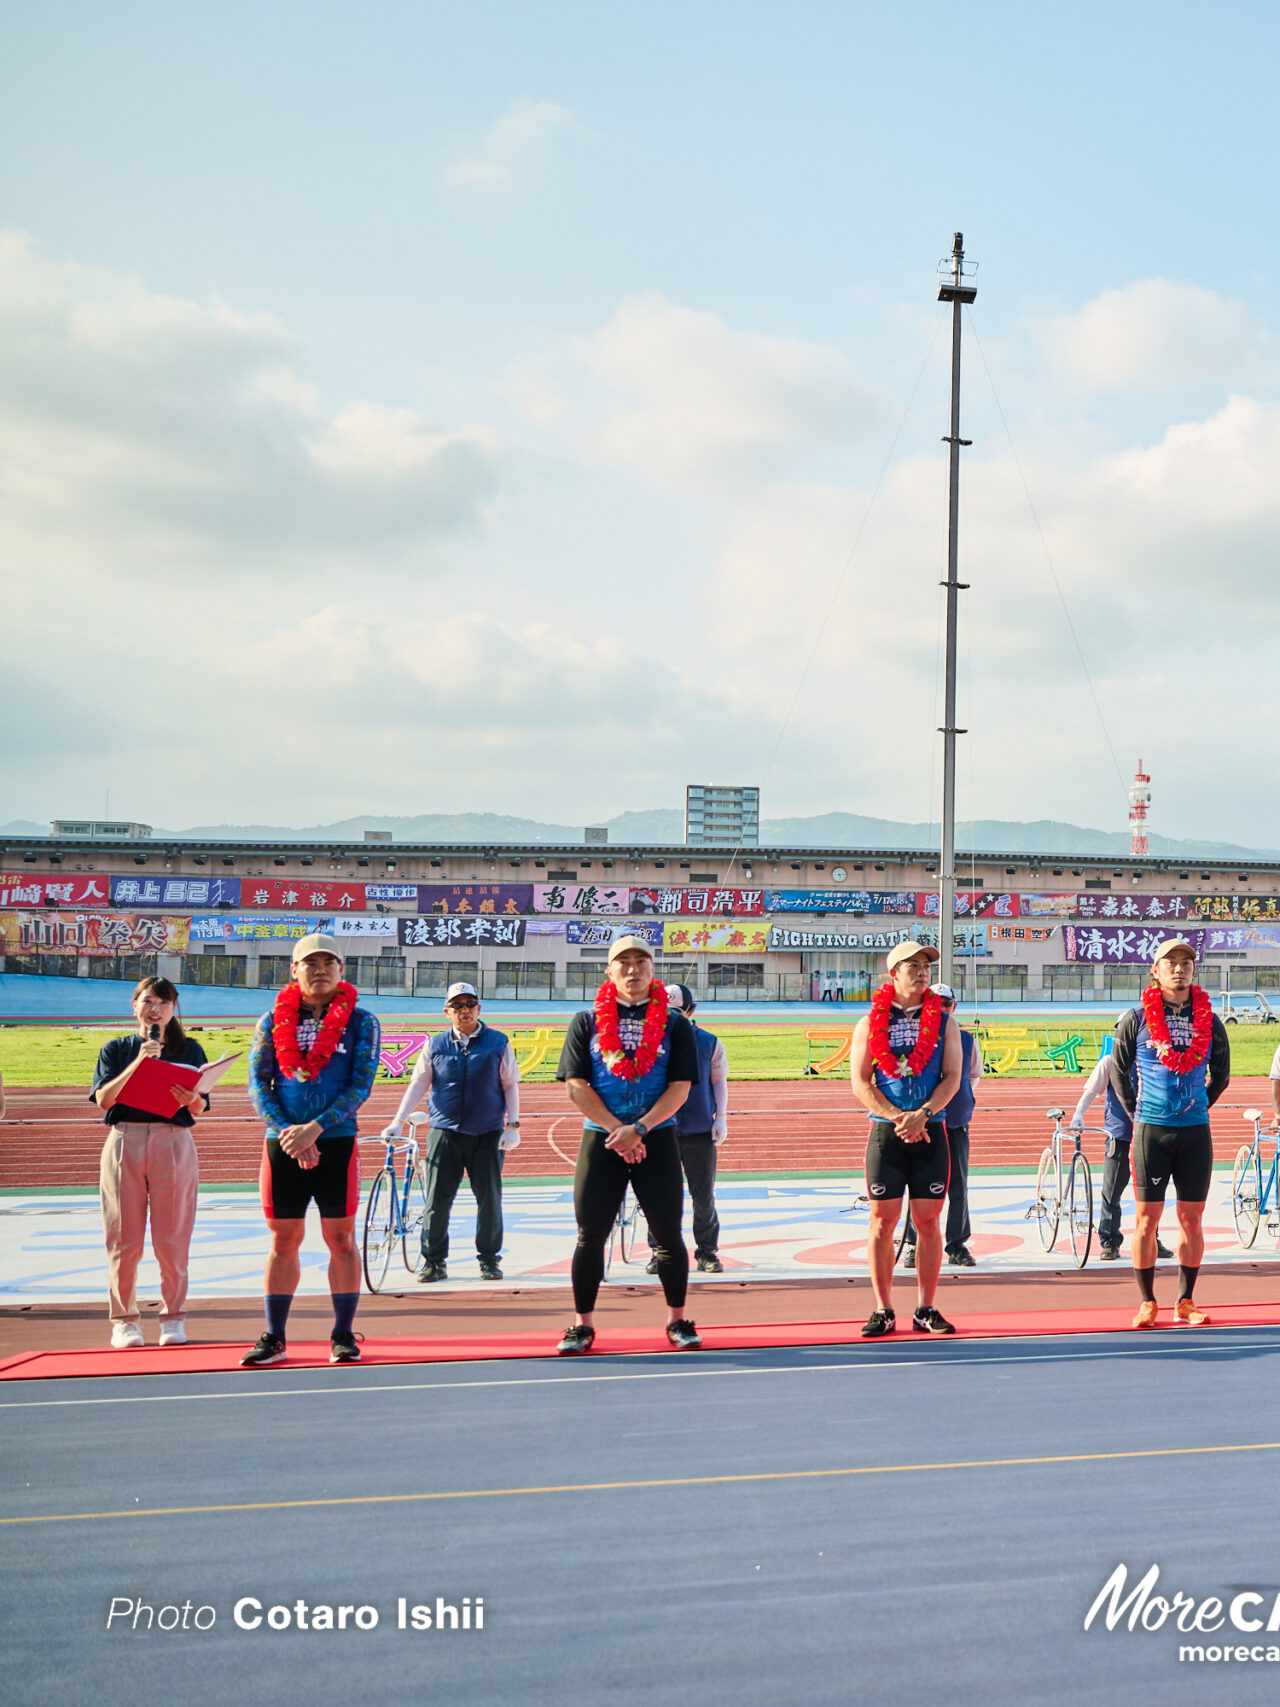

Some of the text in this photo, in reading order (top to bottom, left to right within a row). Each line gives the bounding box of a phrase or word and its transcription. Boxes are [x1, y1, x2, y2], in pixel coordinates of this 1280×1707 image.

[115, 880, 209, 903] 井上昌己
[252, 889, 356, 908] 岩津裕介
[367, 887, 416, 897] 古性優作
[660, 890, 762, 913] 郡司浩平
[199, 917, 219, 929] 大阪
[237, 923, 308, 939] 中釜章成
[342, 920, 390, 931] 鈴木玄人
[771, 926, 909, 948] FIGHTING GATE
